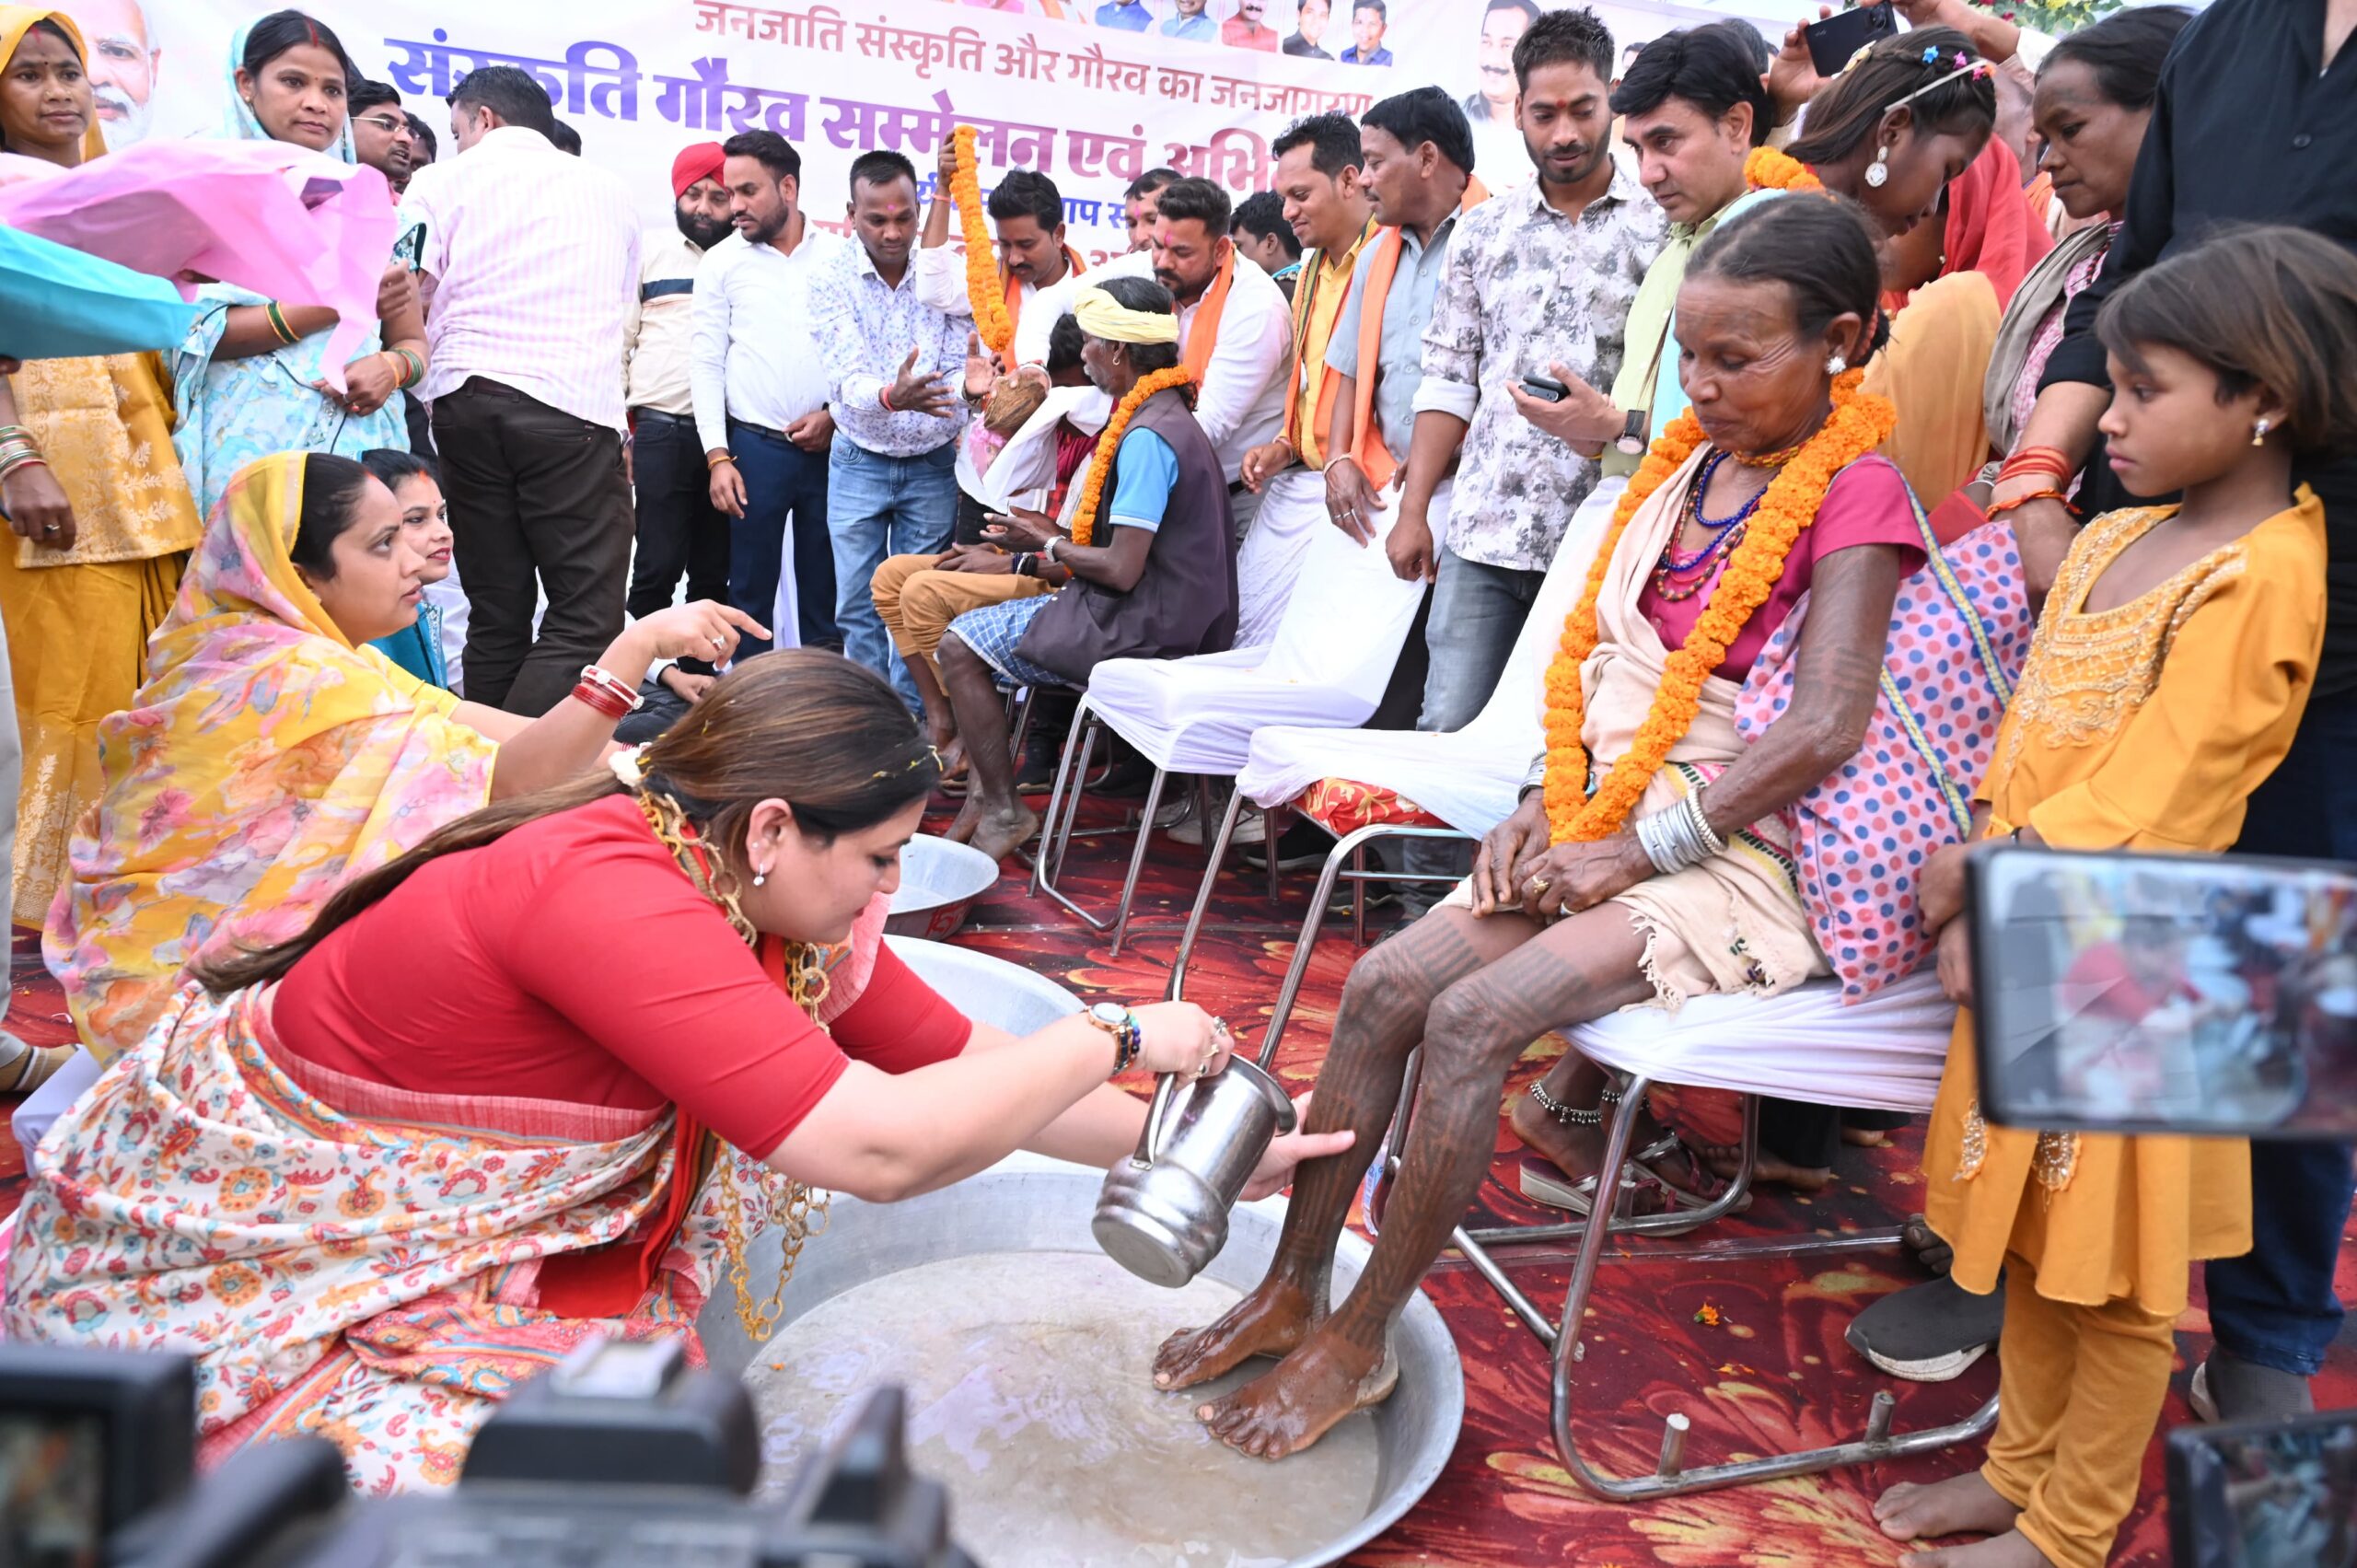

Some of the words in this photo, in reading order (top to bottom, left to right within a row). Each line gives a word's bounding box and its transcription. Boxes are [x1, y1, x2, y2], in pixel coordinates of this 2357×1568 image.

[693, 0, 847, 52] जनजाति
[854, 15, 986, 79] संस्कृति
[994, 32, 1060, 83] और
[1067, 42, 1150, 95] गौरव
[1157, 66, 1204, 103] का
[653, 56, 809, 142] गौरव
[1066, 124, 1147, 182] एवं
